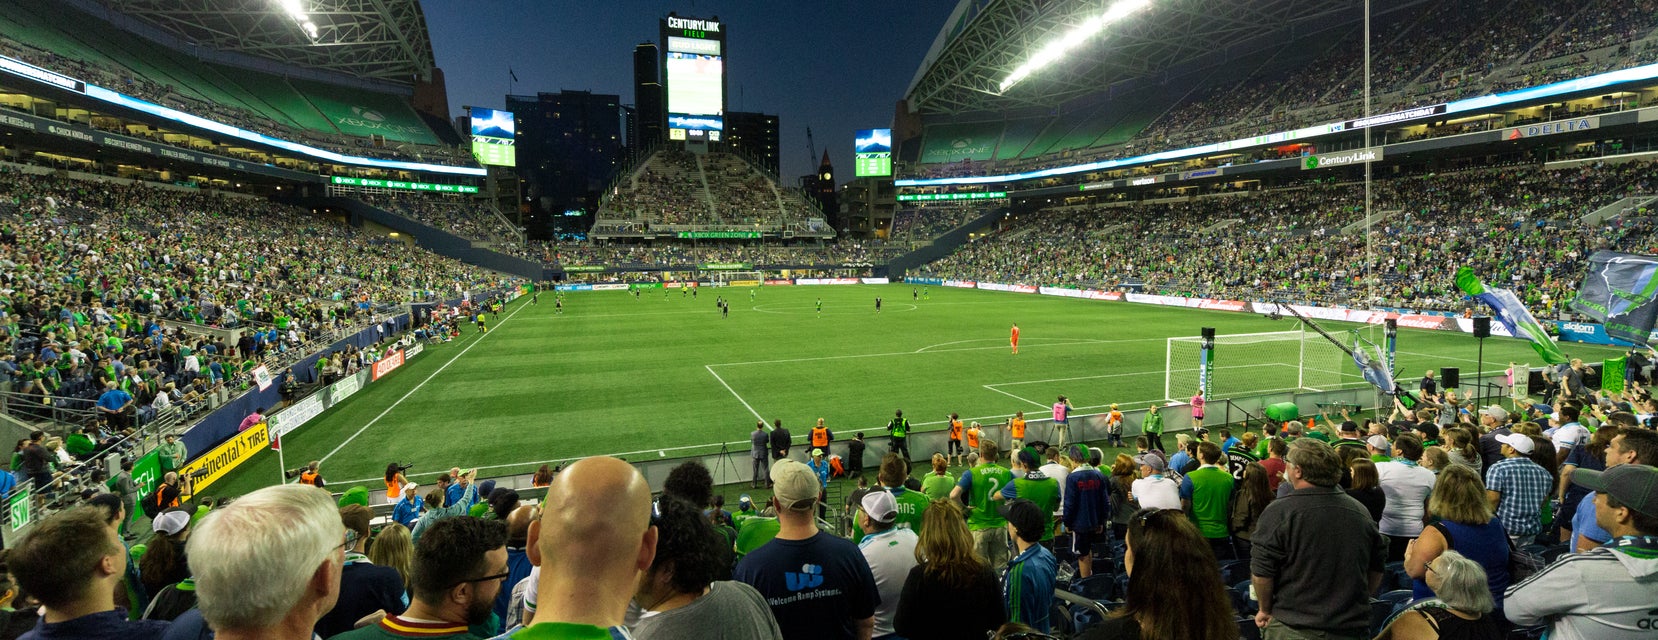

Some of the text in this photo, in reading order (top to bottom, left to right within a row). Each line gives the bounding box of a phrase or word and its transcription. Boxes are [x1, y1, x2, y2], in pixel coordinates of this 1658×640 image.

[668, 17, 720, 32] CENTURYLINK
[684, 30, 705, 38] FIELD
[1528, 118, 1590, 136] DELTA
[1320, 151, 1375, 165] CenturyLink
[1563, 322, 1595, 332] slalom
[247, 429, 266, 449] TIRE
[980, 467, 1003, 475] DEMPSEY
[1233, 463, 1243, 479] 2
[988, 477, 999, 501] 2
[12, 499, 29, 530] SW
[768, 595, 797, 606] Welcome
[797, 591, 814, 600] Ramp
